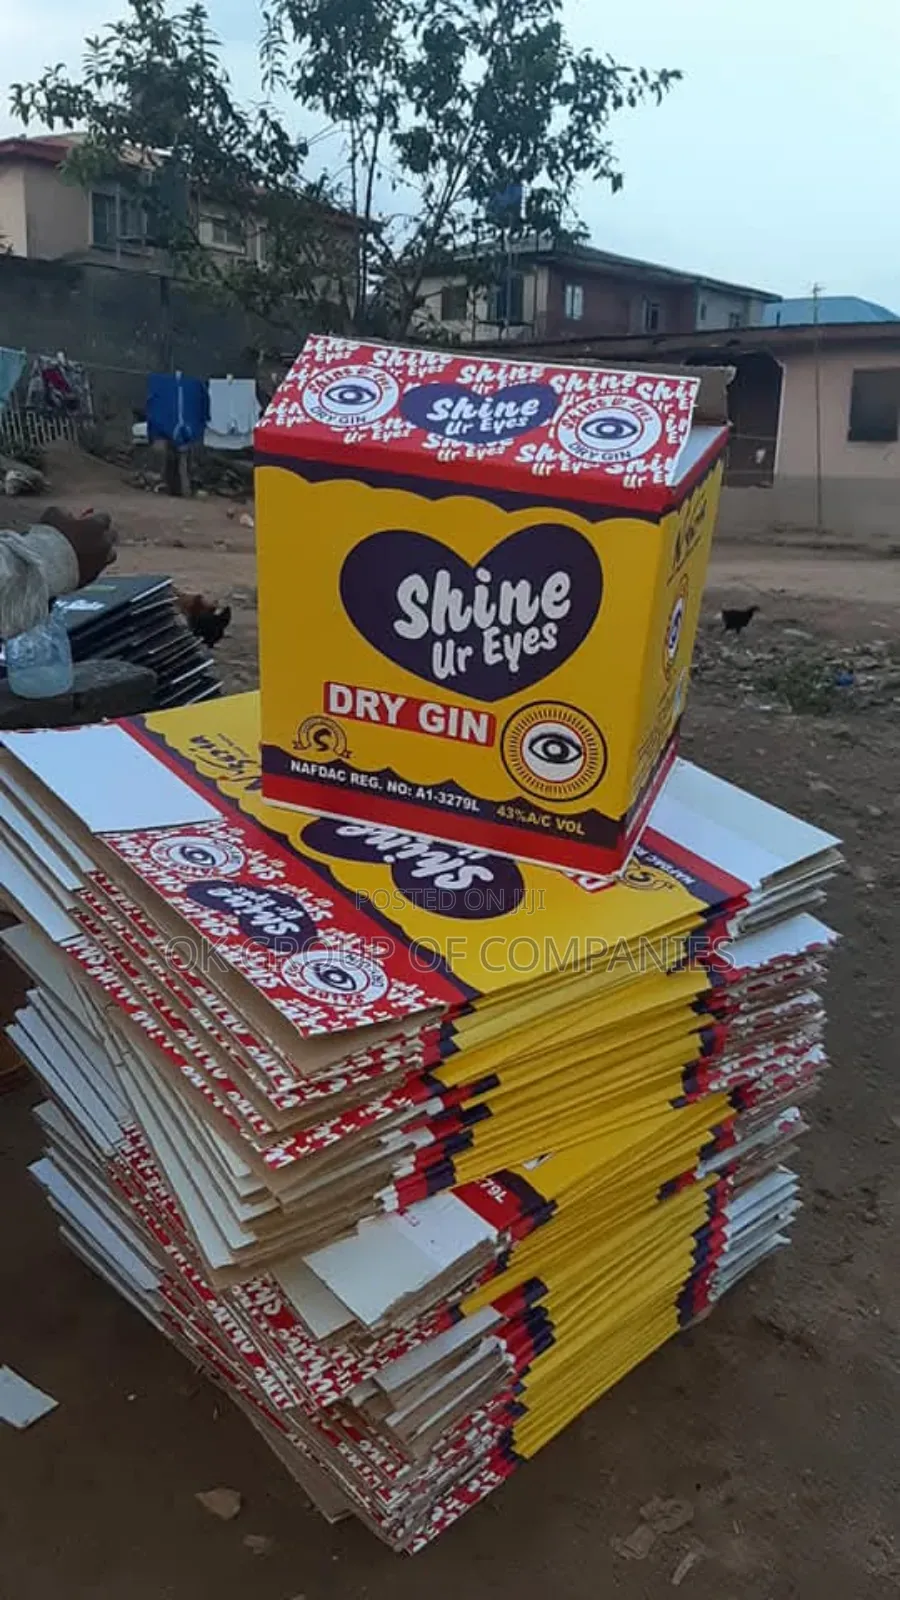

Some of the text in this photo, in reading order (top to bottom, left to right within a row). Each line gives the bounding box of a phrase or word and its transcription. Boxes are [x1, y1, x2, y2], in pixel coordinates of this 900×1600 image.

[456, 364, 545, 384] Shine
[549, 373, 637, 394] Shine
[426, 397, 540, 421] Shine
[338, 415, 367, 425] GIN
[445, 416, 529, 436] Ur Eyes
[343, 431, 368, 445] Ur
[371, 427, 412, 443] Eyes
[437, 446, 507, 463] Ur Eyes
[568, 442, 632, 462] DRY GIN
[532, 461, 557, 477] Ur
[622, 474, 647, 490] Ur
[393, 566, 571, 640] Shine
[432, 622, 558, 680] Ur Eyes
[329, 683, 490, 743] DRY GIN
[290, 759, 481, 813] NAFDAC REG. NO: A1-3279L
[556, 816, 586, 836] VOL
[336, 826, 494, 889] Shine
[207, 887, 300, 935] Shine
